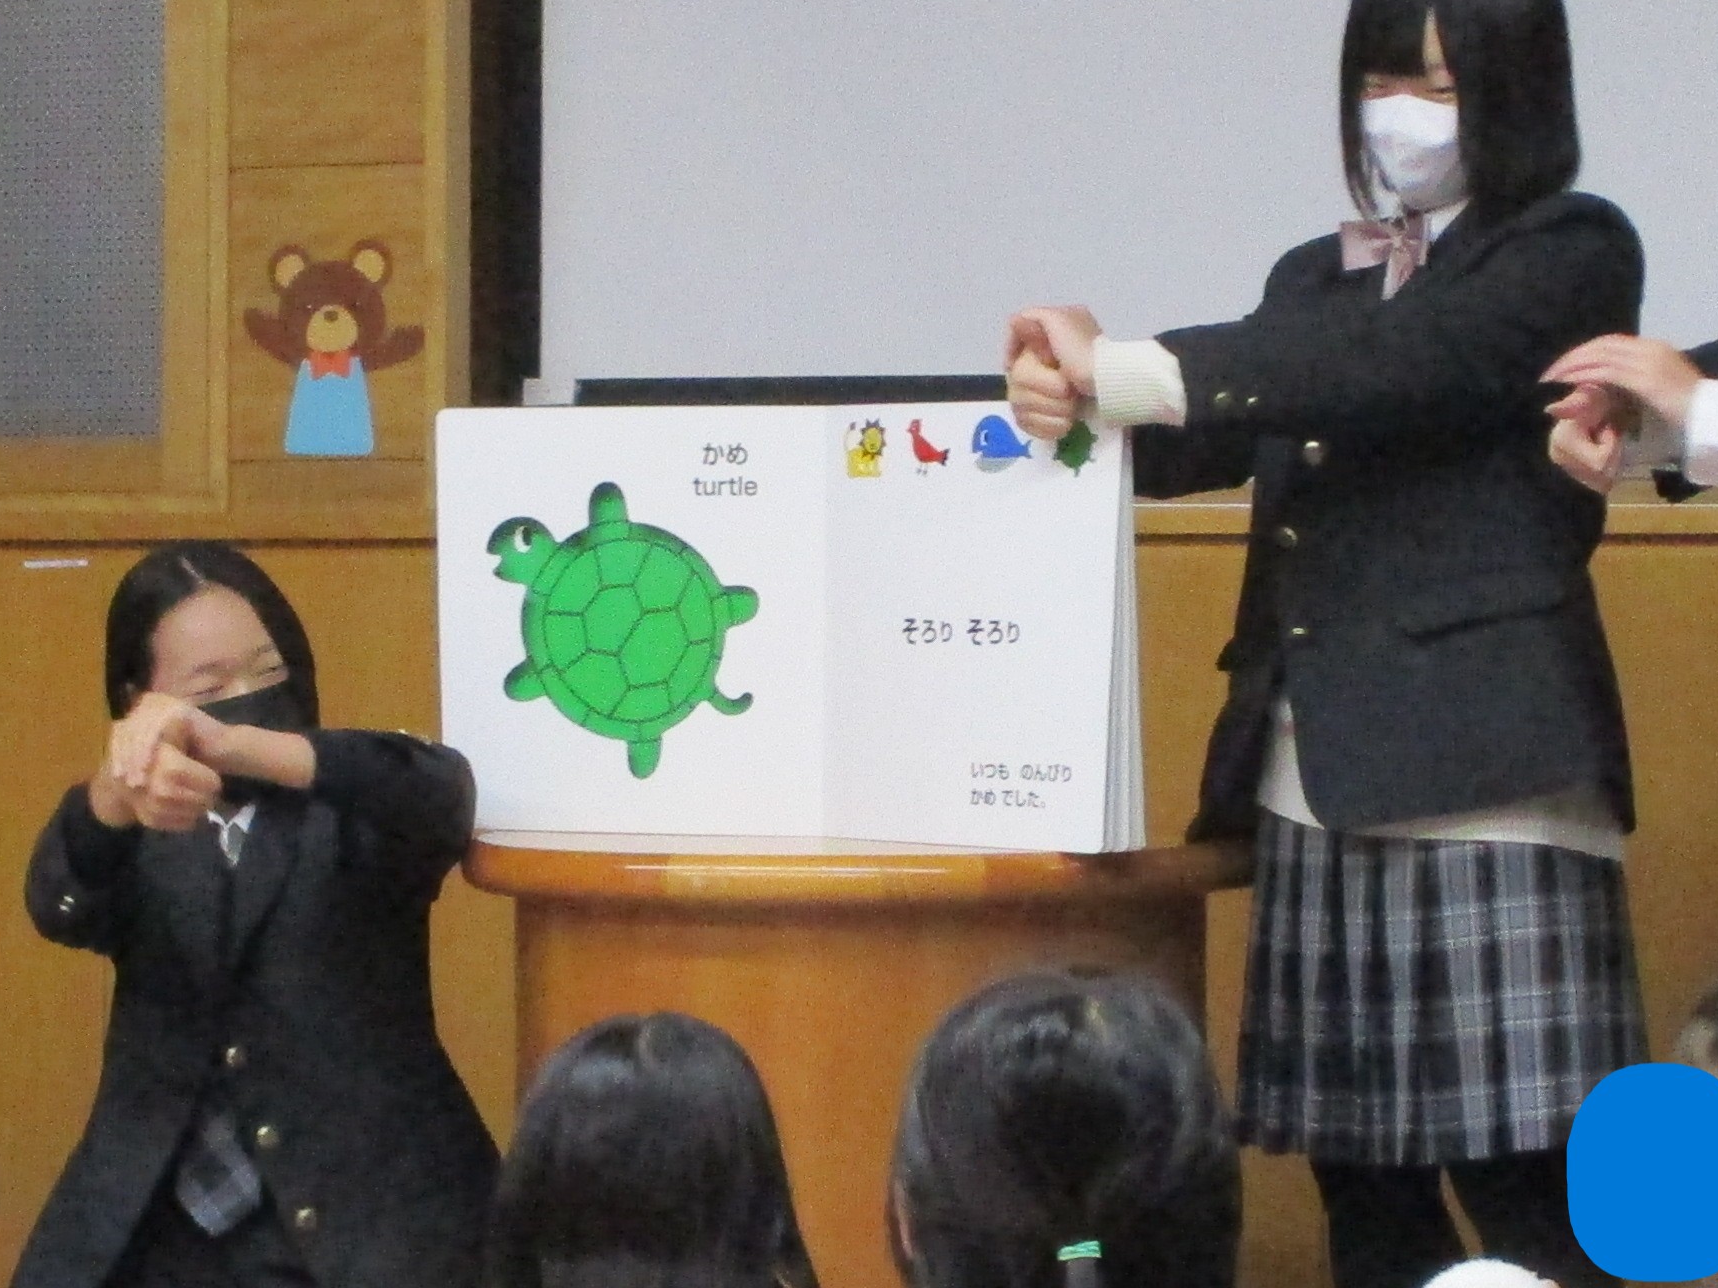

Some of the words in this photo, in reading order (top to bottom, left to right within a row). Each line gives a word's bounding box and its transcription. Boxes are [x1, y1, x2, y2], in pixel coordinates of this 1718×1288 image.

[702, 442, 749, 465] かめ
[693, 476, 758, 496] turtle
[902, 618, 953, 644] そろり
[966, 618, 1020, 645] そろり
[970, 762, 1010, 780] いつも
[1021, 763, 1072, 782] のんびり
[970, 788, 997, 806] かめ
